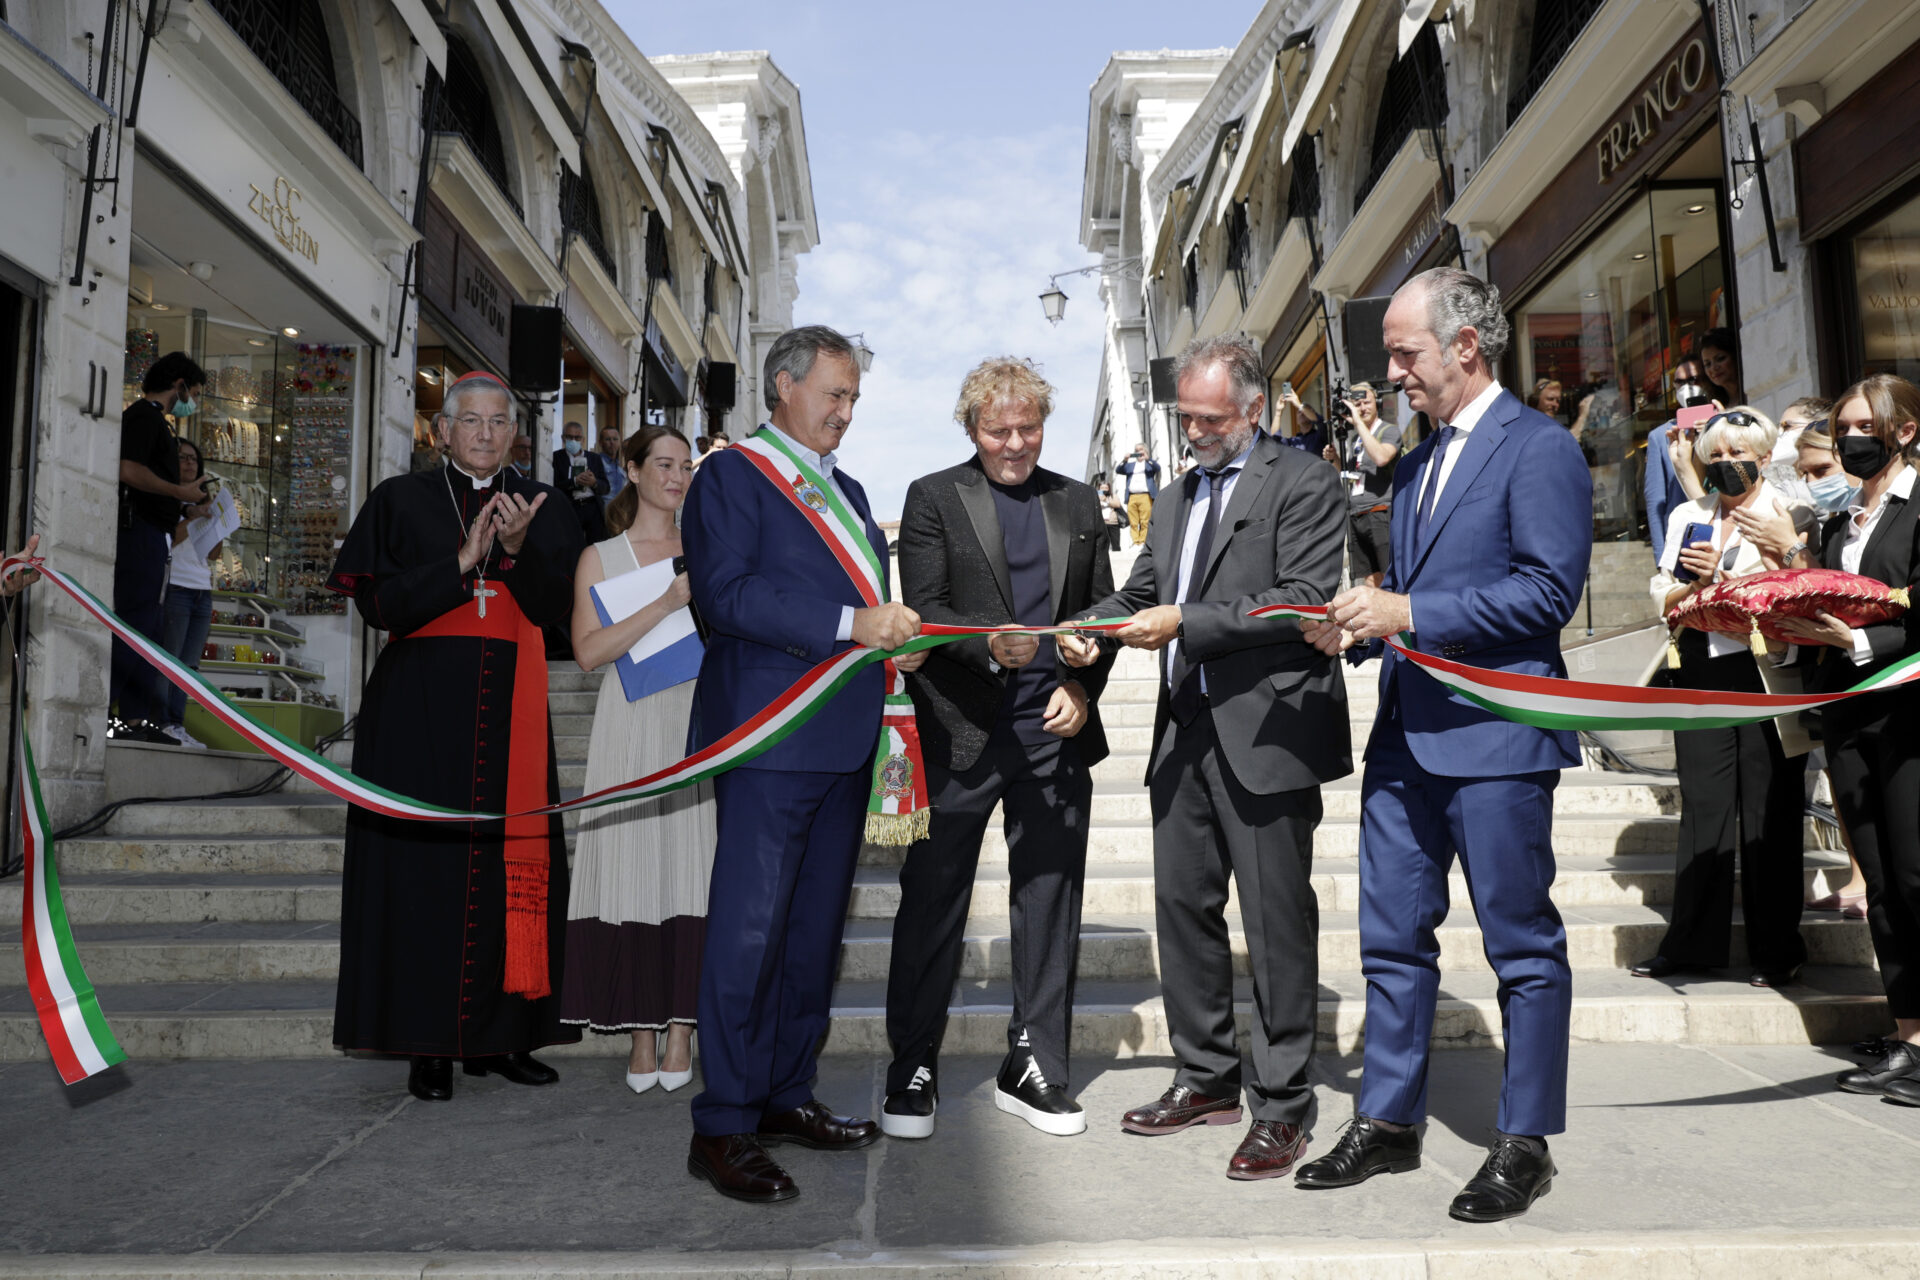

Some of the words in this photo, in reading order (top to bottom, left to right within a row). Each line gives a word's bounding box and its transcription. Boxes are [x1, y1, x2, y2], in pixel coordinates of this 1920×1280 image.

[1596, 37, 1706, 185] FRANCO
[247, 182, 320, 265] ZECCHIN
[1868, 294, 1920, 309] VALMO
